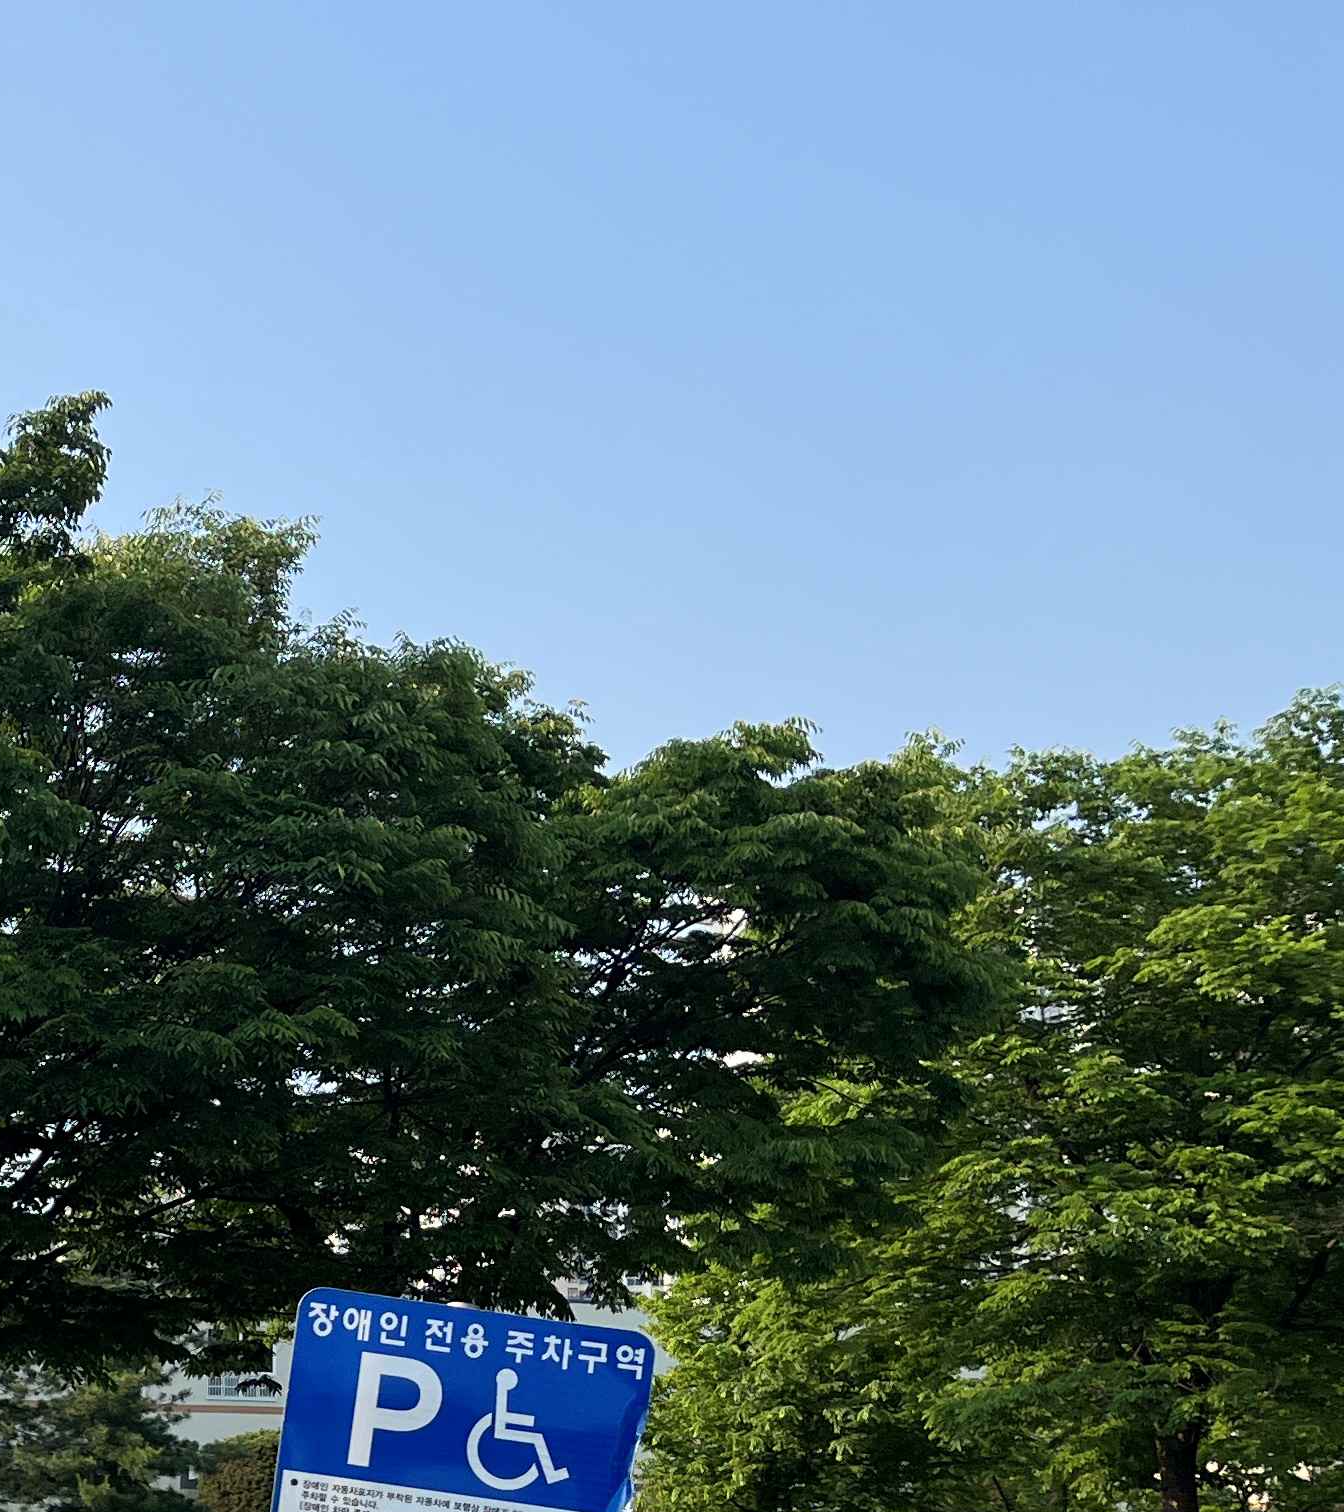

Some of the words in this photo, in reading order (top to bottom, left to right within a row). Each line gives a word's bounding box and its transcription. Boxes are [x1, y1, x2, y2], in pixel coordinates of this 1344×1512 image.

[308, 1302, 407, 1346] 장애인
[425, 1318, 489, 1358] 전용
[505, 1328, 646, 1379] 주차구역
[347, 1351, 443, 1467] P
[303, 1480, 328, 1490] 장애인
